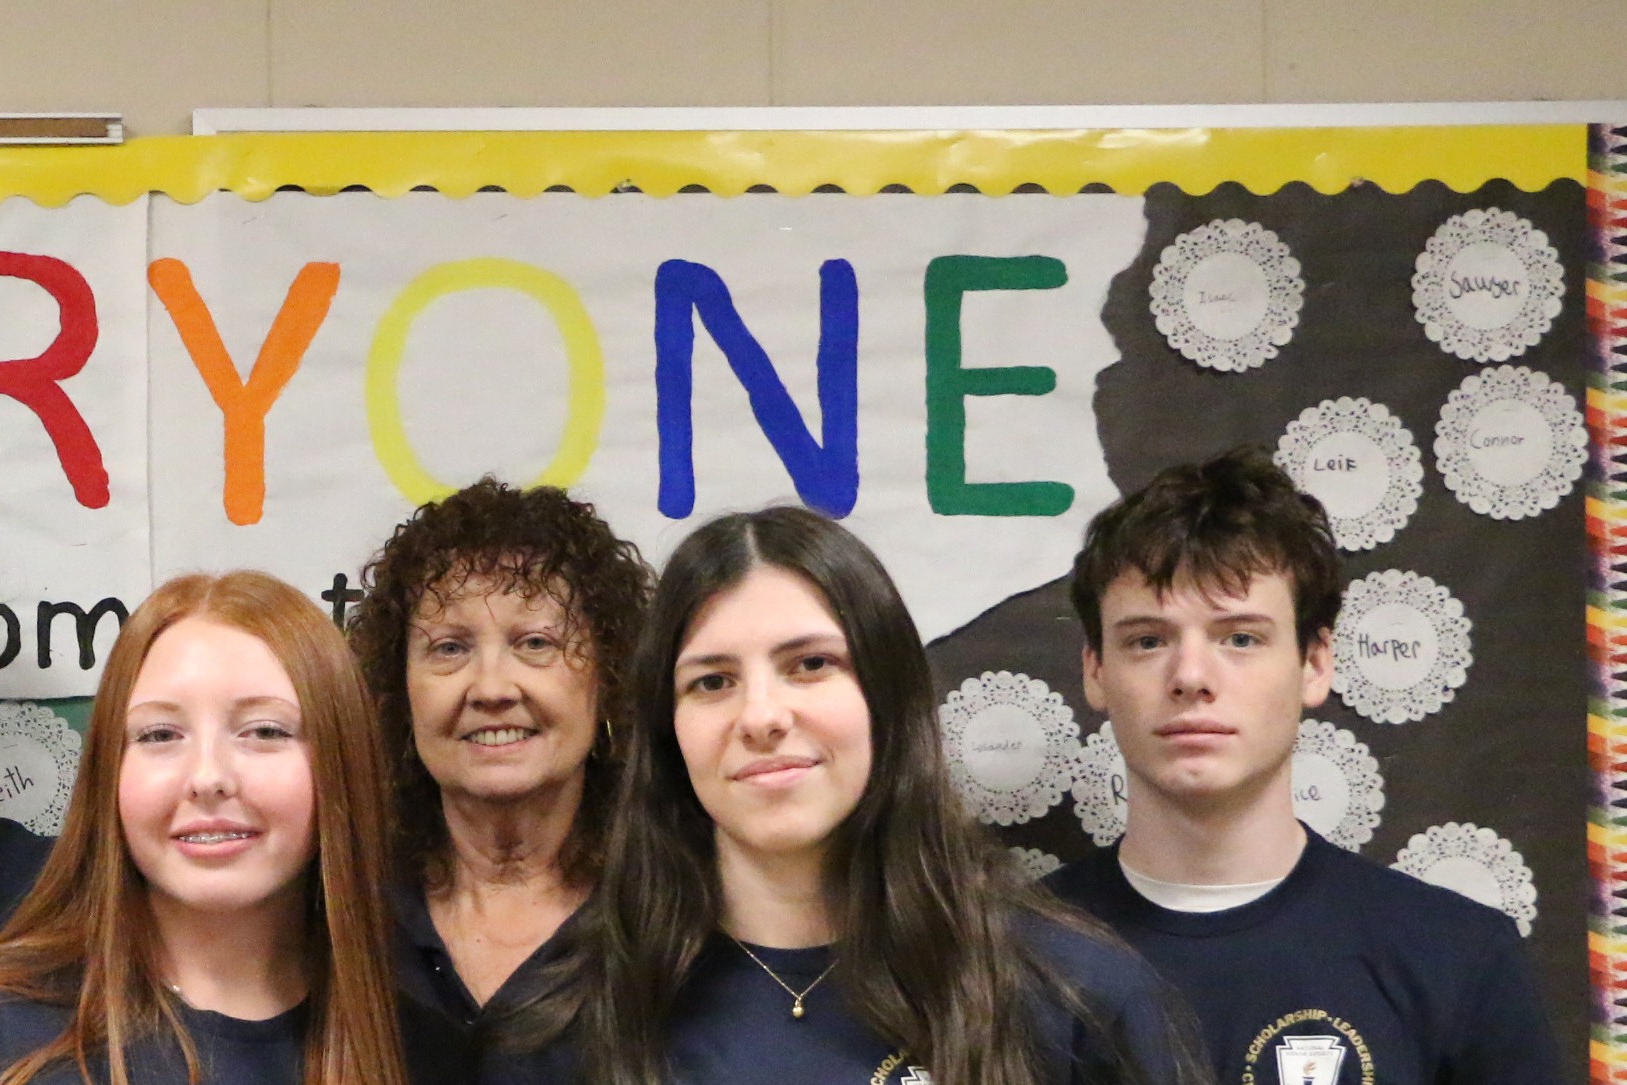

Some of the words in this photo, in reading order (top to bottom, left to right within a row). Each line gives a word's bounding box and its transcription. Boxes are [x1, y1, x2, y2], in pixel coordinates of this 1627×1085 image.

[1449, 271, 1520, 299] Sawyer
[1470, 428, 1525, 450] Connor
[1245, 1008, 1328, 1064] SCHOLARSHIP
